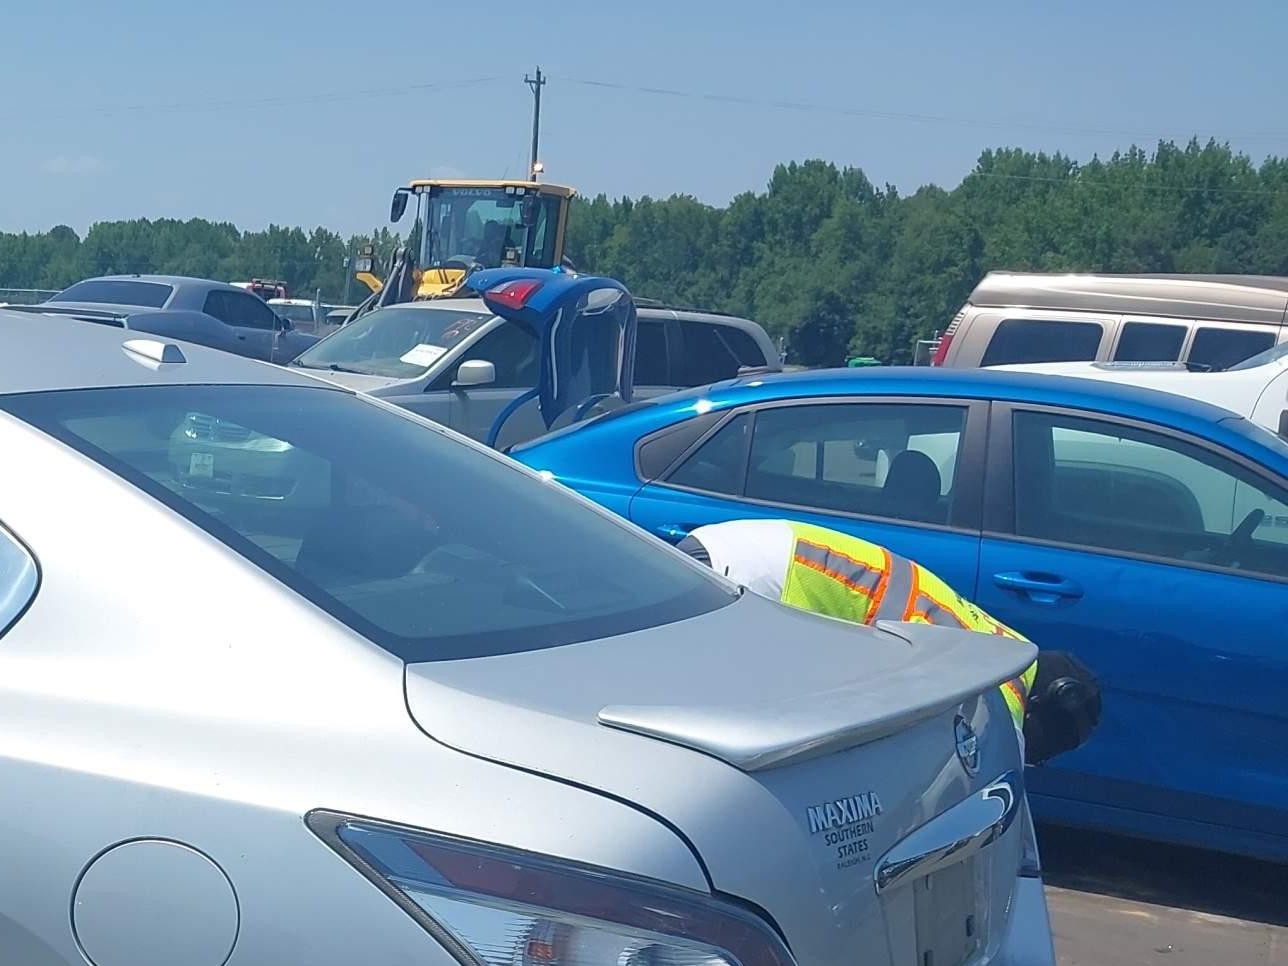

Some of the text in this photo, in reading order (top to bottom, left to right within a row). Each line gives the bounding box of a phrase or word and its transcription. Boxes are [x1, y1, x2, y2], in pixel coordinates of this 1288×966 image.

[807, 791, 883, 833] MAXIMA
[824, 821, 874, 847] SOUTHERN
[837, 839, 868, 859] STATES
